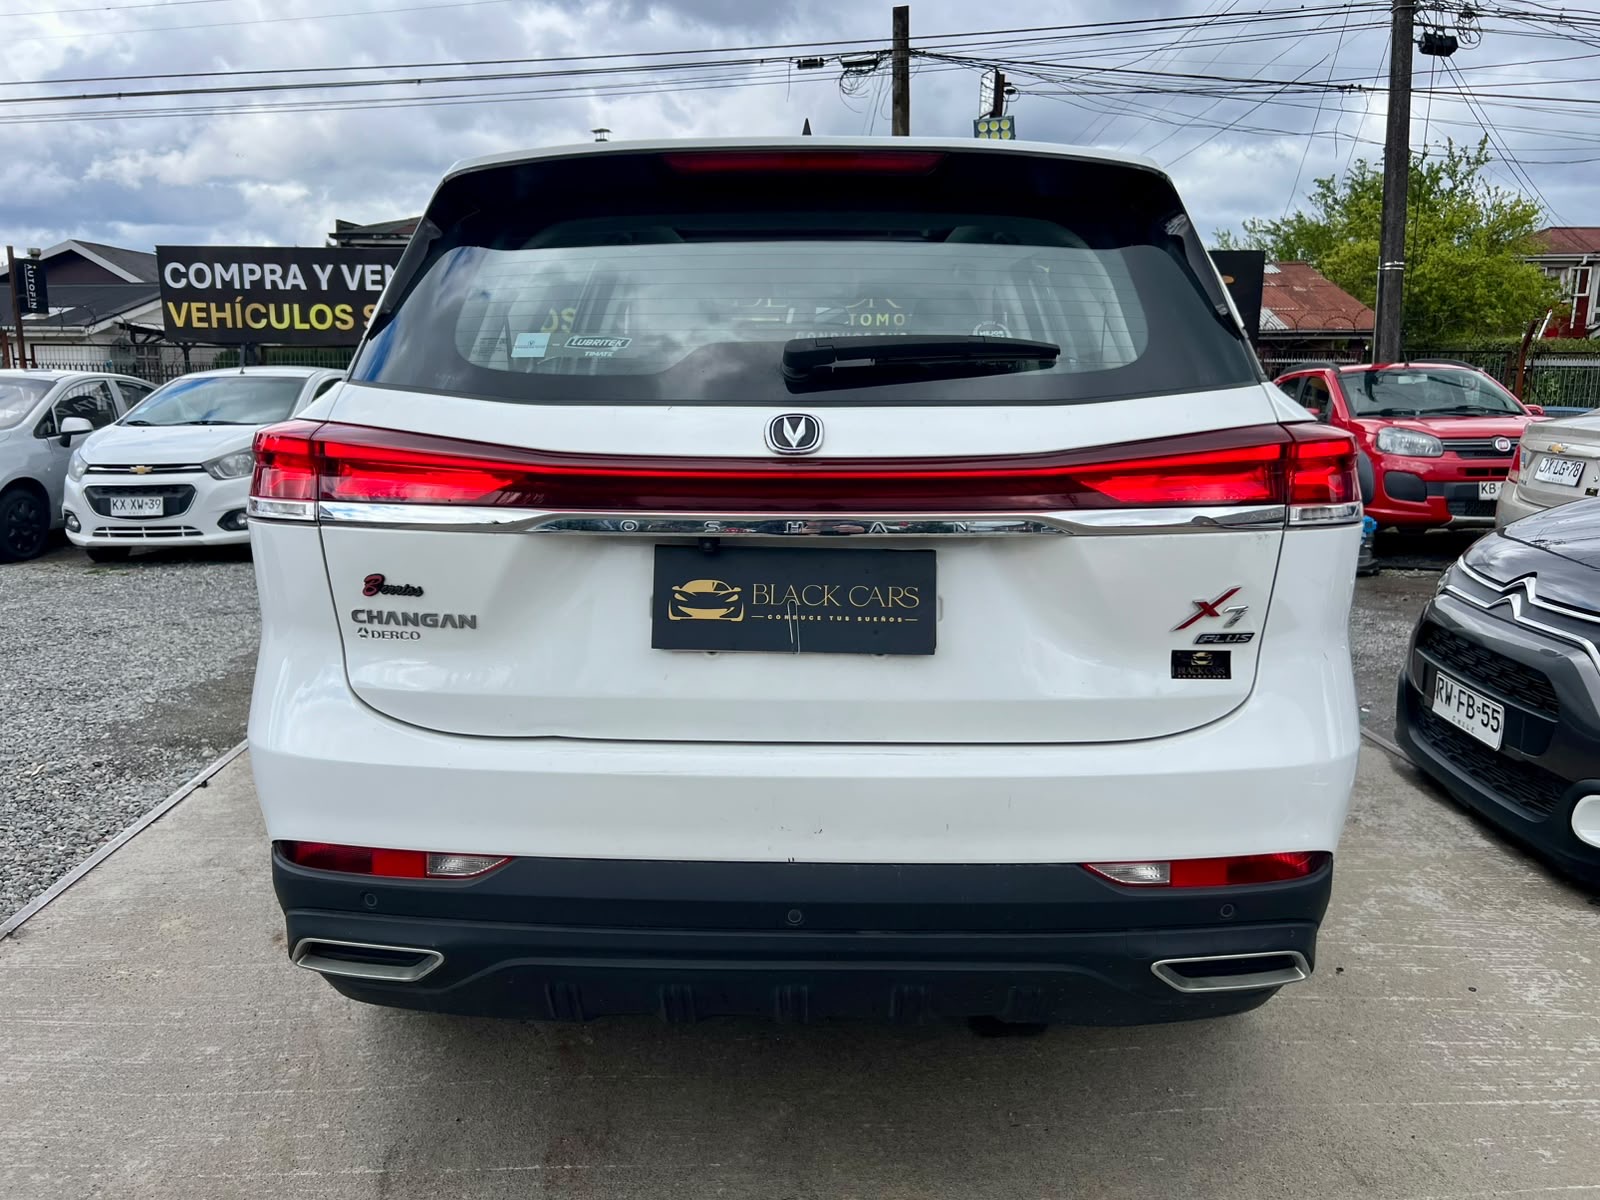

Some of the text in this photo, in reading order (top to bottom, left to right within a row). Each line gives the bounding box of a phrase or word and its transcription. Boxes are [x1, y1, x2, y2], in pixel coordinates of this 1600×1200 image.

[26, 263, 38, 309] AUTOFIN
[164, 262, 307, 290] COMPRA
[313, 264, 334, 291] Y
[167, 296, 354, 331] VEHÍCULOS
[570, 337, 624, 347] LUBRITEK
[619, 520, 970, 534] OSHAN
[752, 584, 920, 609] BLACK CARS
[857, 614, 903, 622] SUEÑOS
[1169, 585, 1249, 632] X7
[351, 609, 477, 629] CHANGAN
[371, 630, 421, 640] DERCO
[1196, 633, 1253, 643] PLUS
